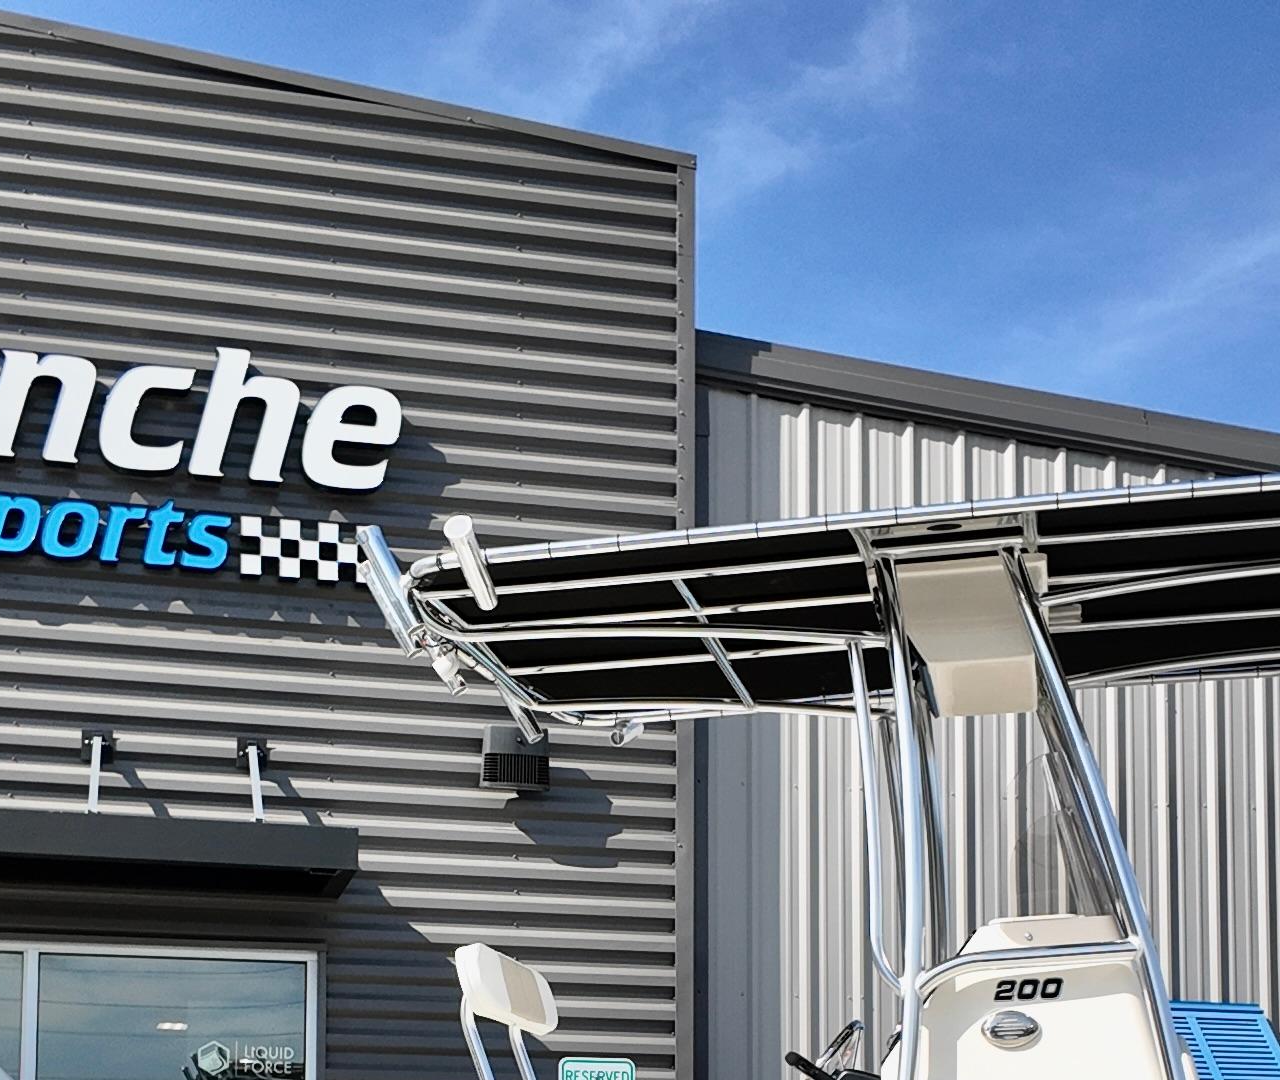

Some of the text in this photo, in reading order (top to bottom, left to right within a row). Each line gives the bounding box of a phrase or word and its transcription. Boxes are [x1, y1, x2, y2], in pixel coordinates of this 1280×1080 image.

[993, 976, 1064, 1001] 200
[244, 1045, 294, 1060] LIQUID
[243, 1062, 292, 1074] FORCE
